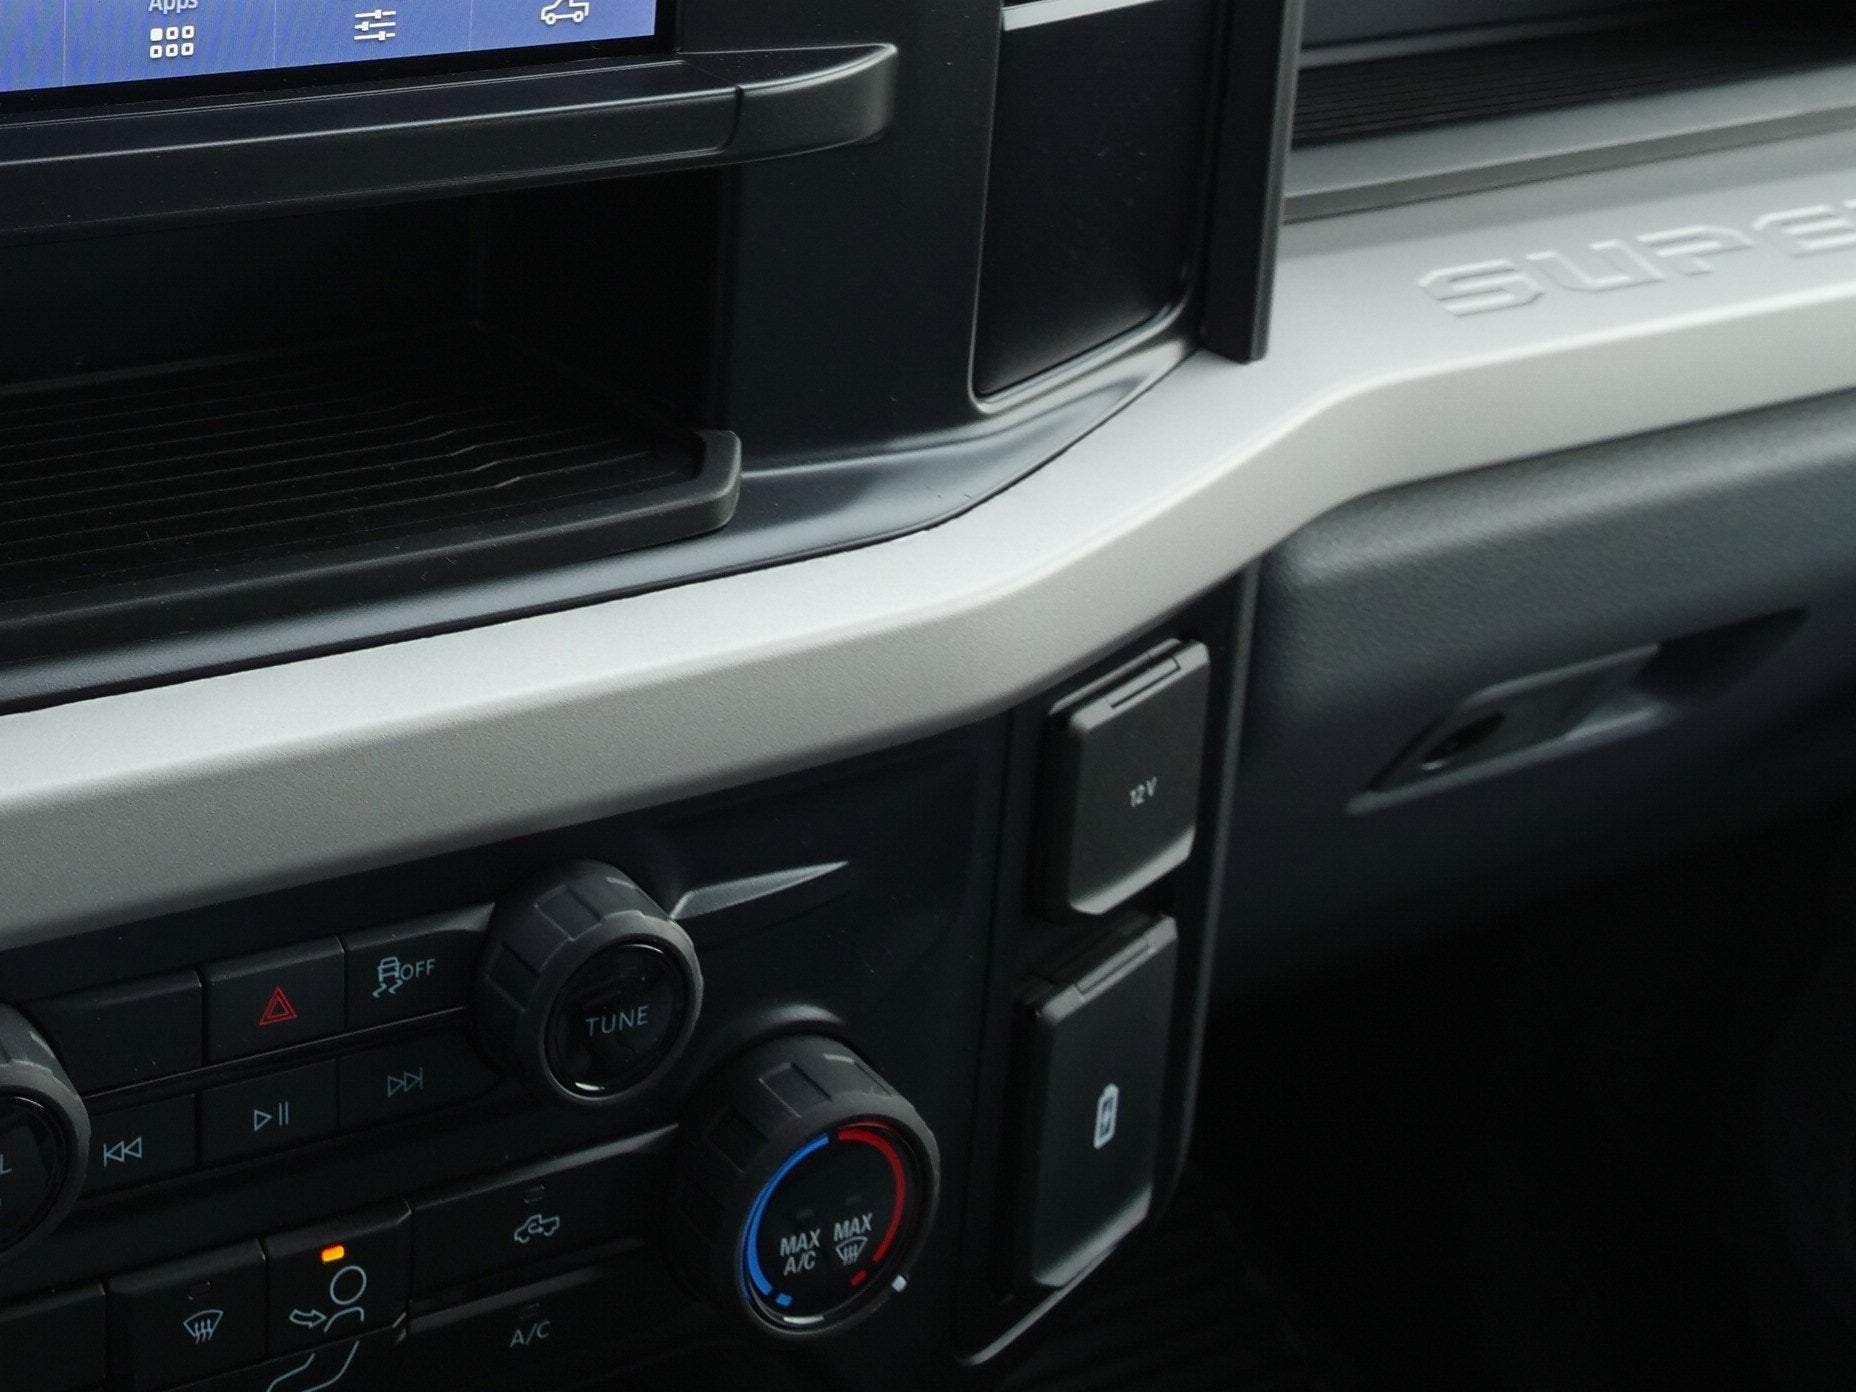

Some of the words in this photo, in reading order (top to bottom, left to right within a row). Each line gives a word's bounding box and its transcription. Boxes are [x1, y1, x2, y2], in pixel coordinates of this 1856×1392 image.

[1418, 200, 1856, 317] SUPE
[400, 958, 436, 981] OFF
[585, 1005, 649, 1037] TUNE
[834, 1212, 873, 1242] MAX
[780, 1228, 821, 1258] MAX
[784, 1251, 817, 1276] A/C
[510, 1320, 551, 1348] A/C
